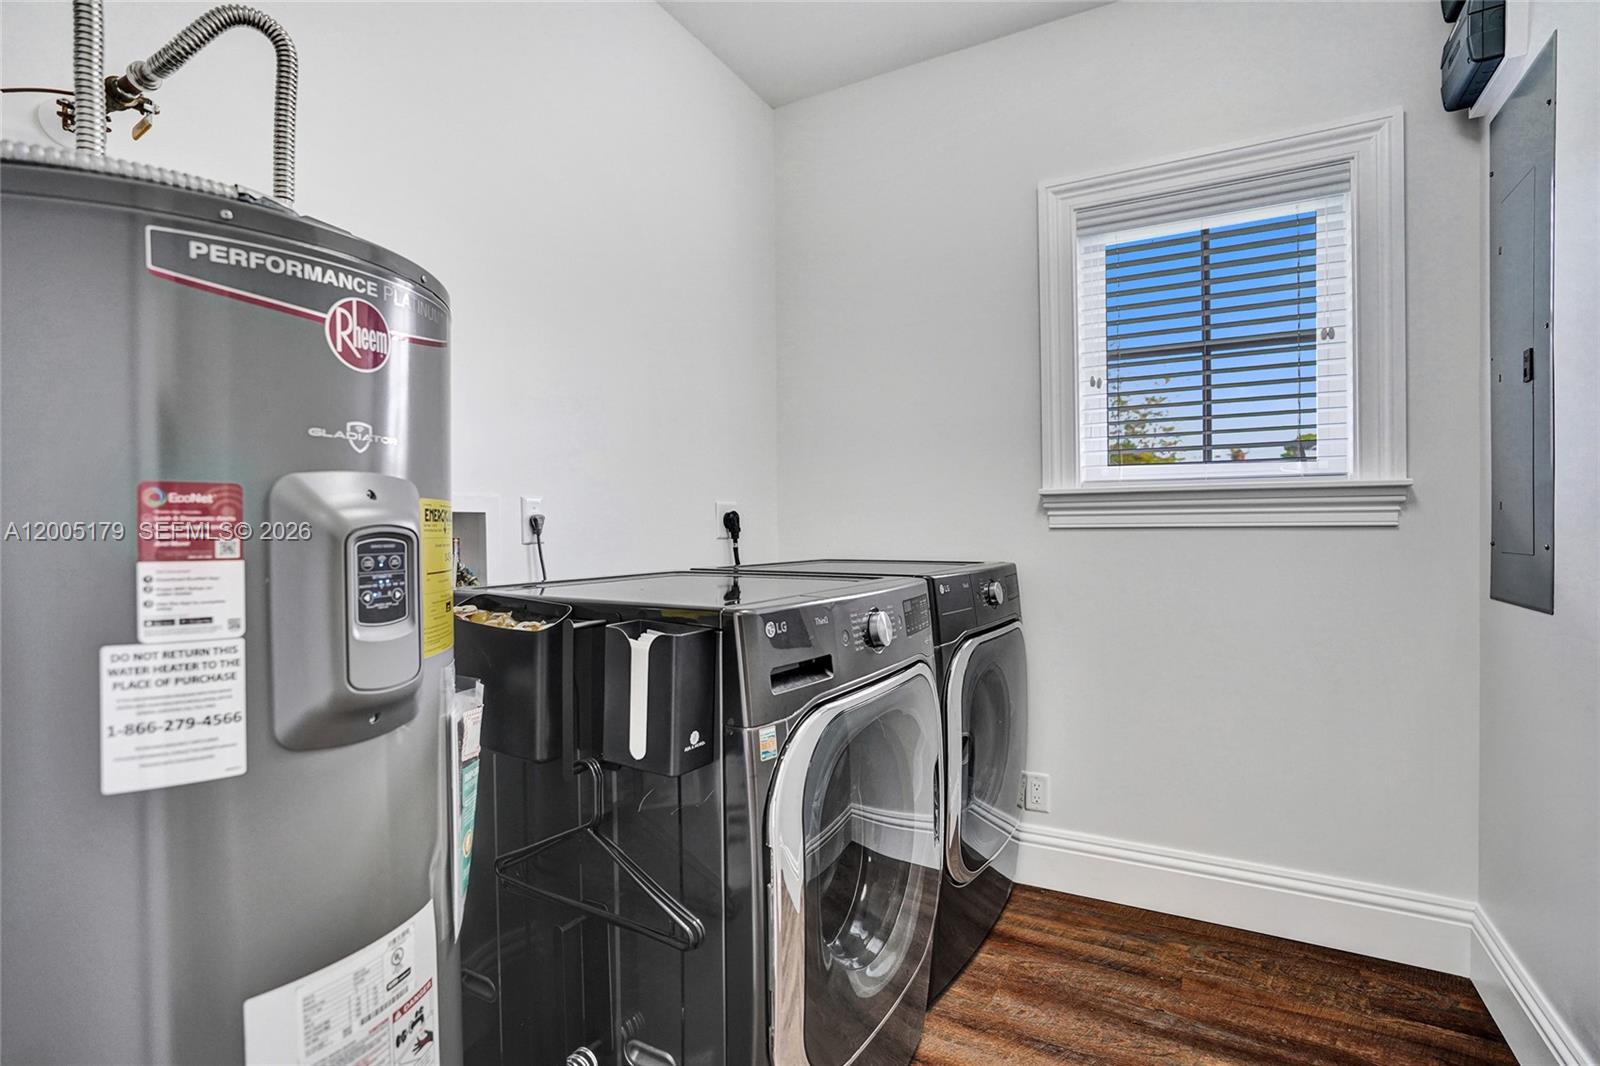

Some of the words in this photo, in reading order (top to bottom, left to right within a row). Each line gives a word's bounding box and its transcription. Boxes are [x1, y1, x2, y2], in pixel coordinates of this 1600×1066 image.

[188, 240, 378, 298] PERFORMANCE
[335, 299, 388, 359] Rheem
[308, 427, 398, 446] GLADIATOR
[167, 492, 214, 504] EcoNet
[110, 653, 130, 663] DO
[133, 651, 159, 661] NOT
[162, 647, 210, 660] RETURN
[213, 645, 239, 656] THIS
[107, 666, 150, 677] WATER
[153, 662, 200, 674] HEATER
[203, 660, 217, 670] TO
[219, 658, 241, 668] THE
[112, 680, 150, 691] PLACE
[154, 677, 171, 688] OF
[174, 671, 237, 686] PURCHASE
[107, 710, 242, 739] 1-866-279-4566
